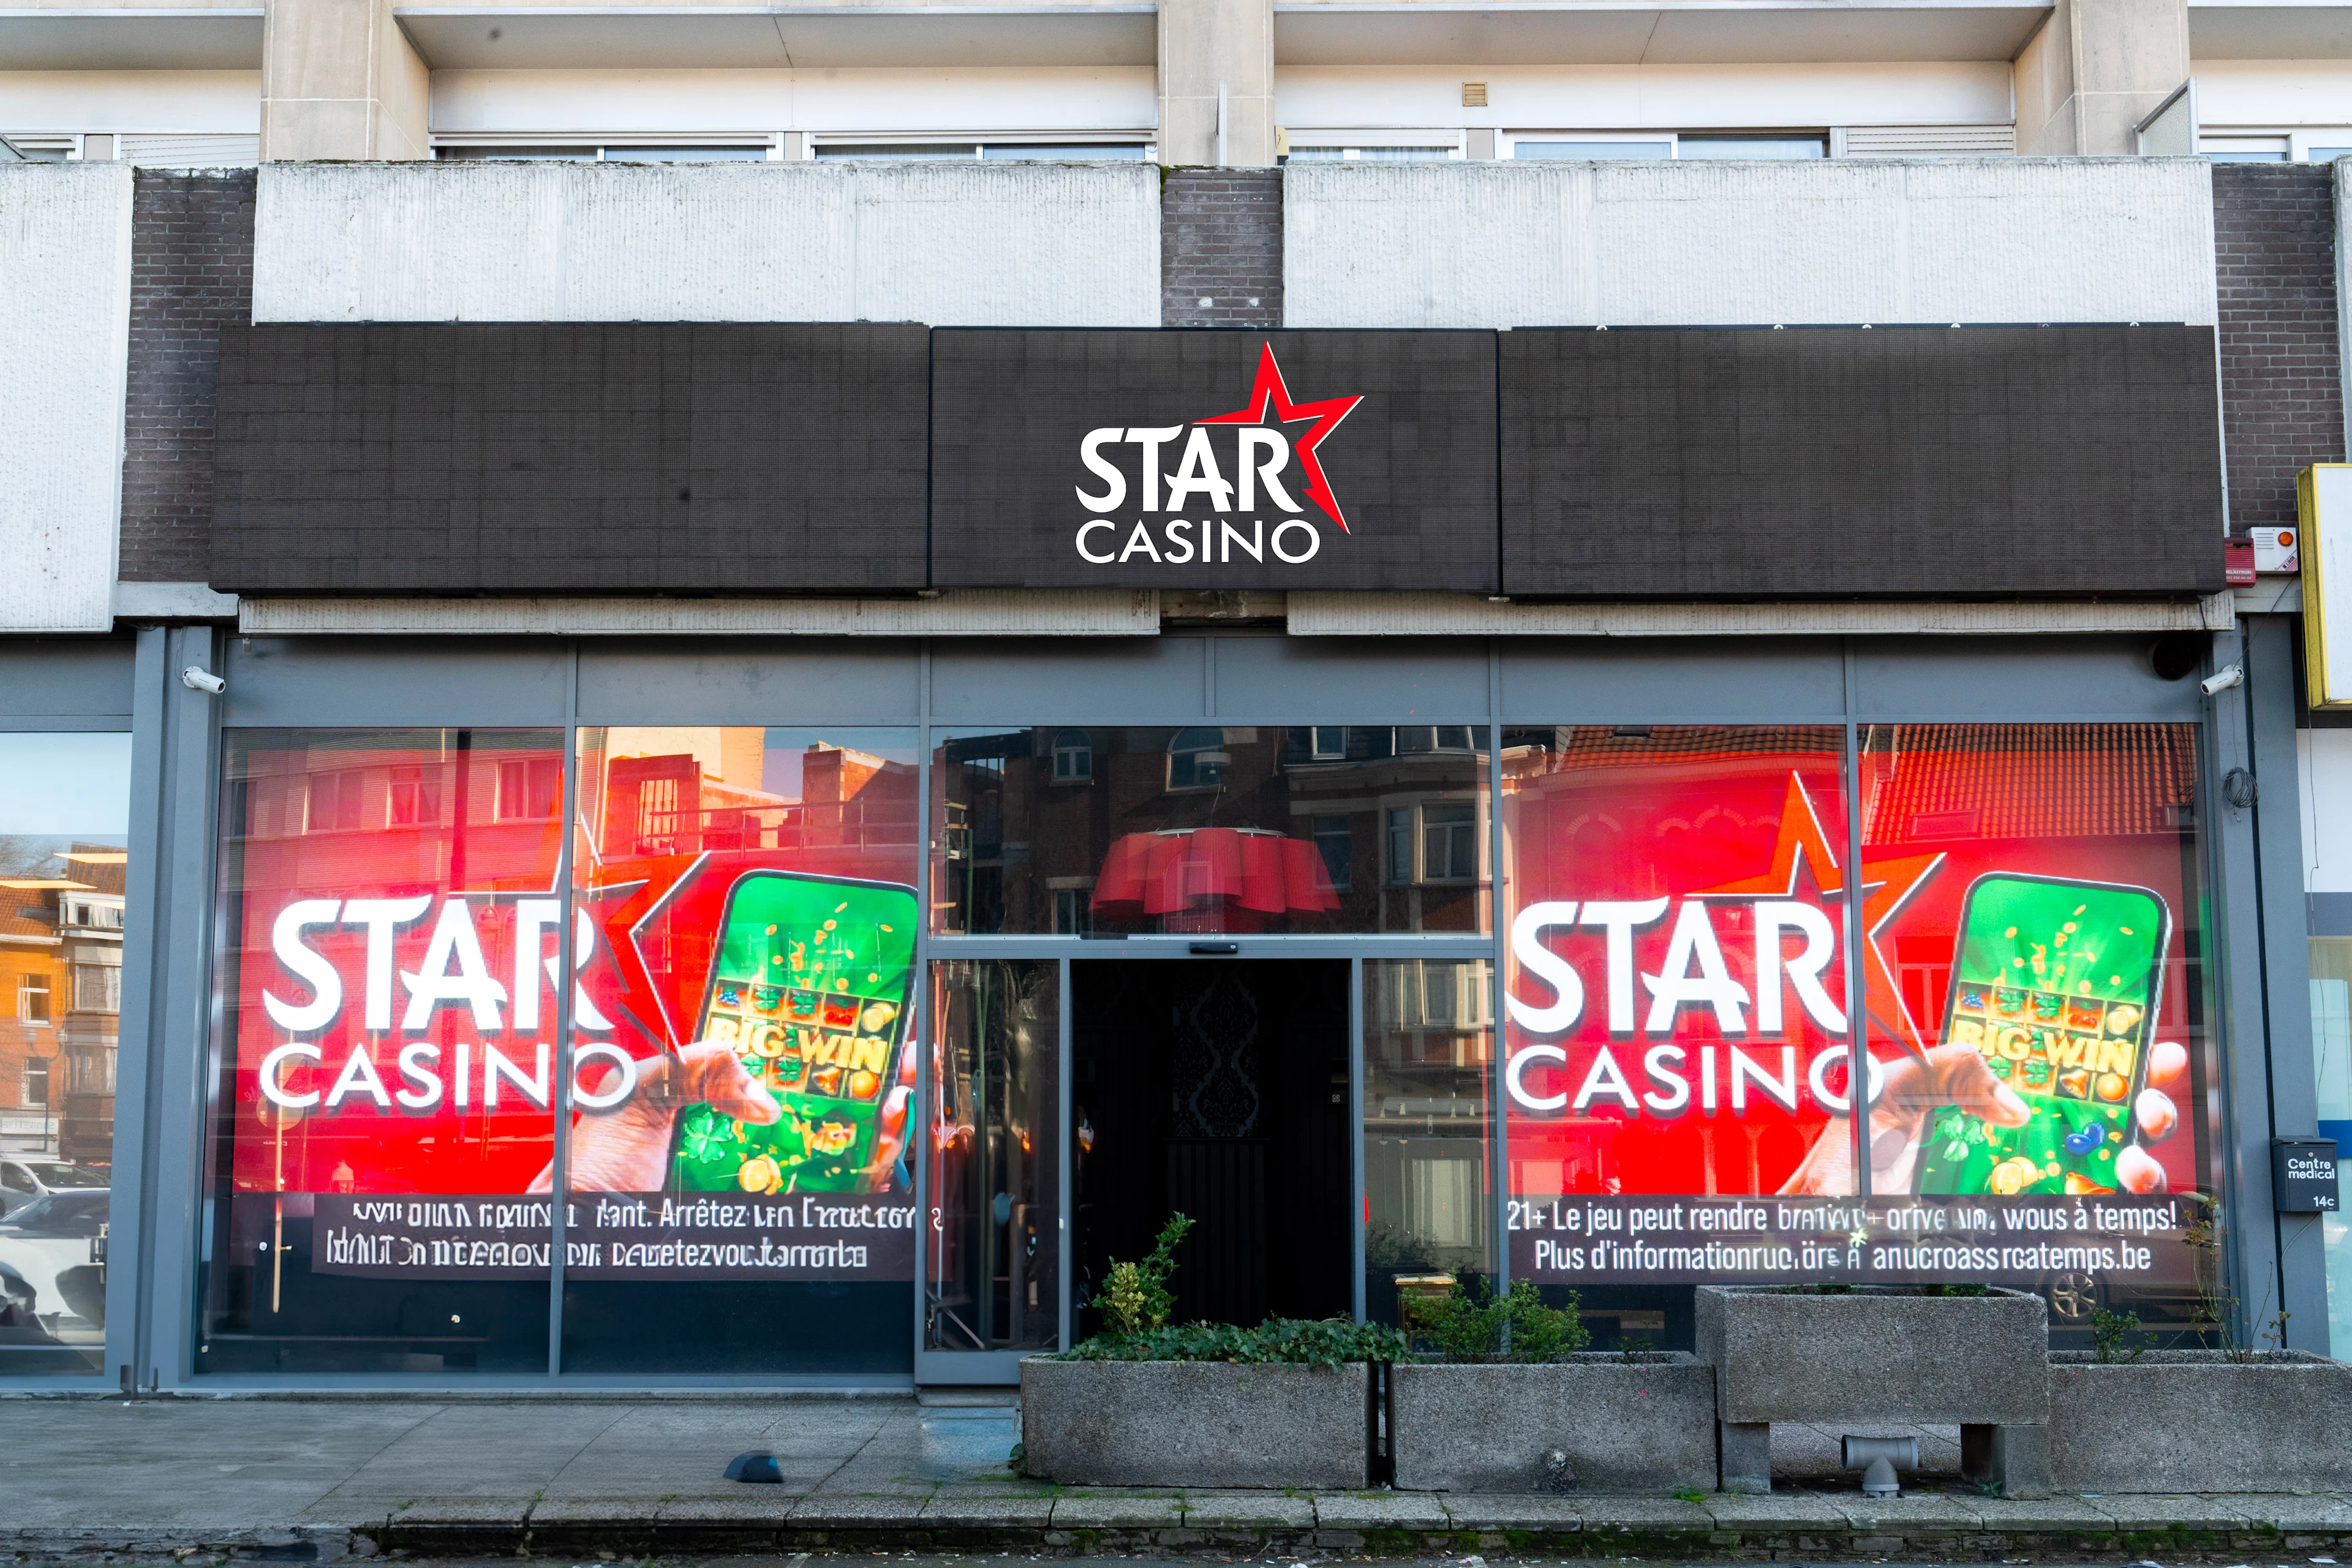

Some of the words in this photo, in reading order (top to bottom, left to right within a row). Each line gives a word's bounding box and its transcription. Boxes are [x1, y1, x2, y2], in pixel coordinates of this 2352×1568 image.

[1076, 423, 1305, 513] STAR
[1076, 519, 1320, 564] CASINO
[263, 894, 615, 1031] STAR
[1505, 896, 1847, 1033] STAR
[709, 1017, 786, 1058] BIG
[797, 1030, 888, 1073] WIN
[1953, 1019, 2032, 1061] BIG
[2043, 1031, 2135, 1077] WIN
[259, 1042, 636, 1108] CASINO
[1507, 1044, 1883, 1110] CASINO
[2288, 1158, 2331, 1169] Centre
[2288, 1168, 2335, 1179] medical
[660, 1198, 747, 1227] Arrêtez
[1507, 1200, 1546, 1231] 21+
[1553, 1202, 1580, 1231] Le
[1586, 1203, 1621, 1237] jeu
[1630, 1203, 1683, 1236] peut
[1690, 1201, 1767, 1231] rendre
[2074, 1201, 2089, 1231] à
[2094, 1200, 2177, 1235] temps!
[2313, 1196, 2334, 1207] 14c
[1536, 1240, 1583, 1270] Plus
